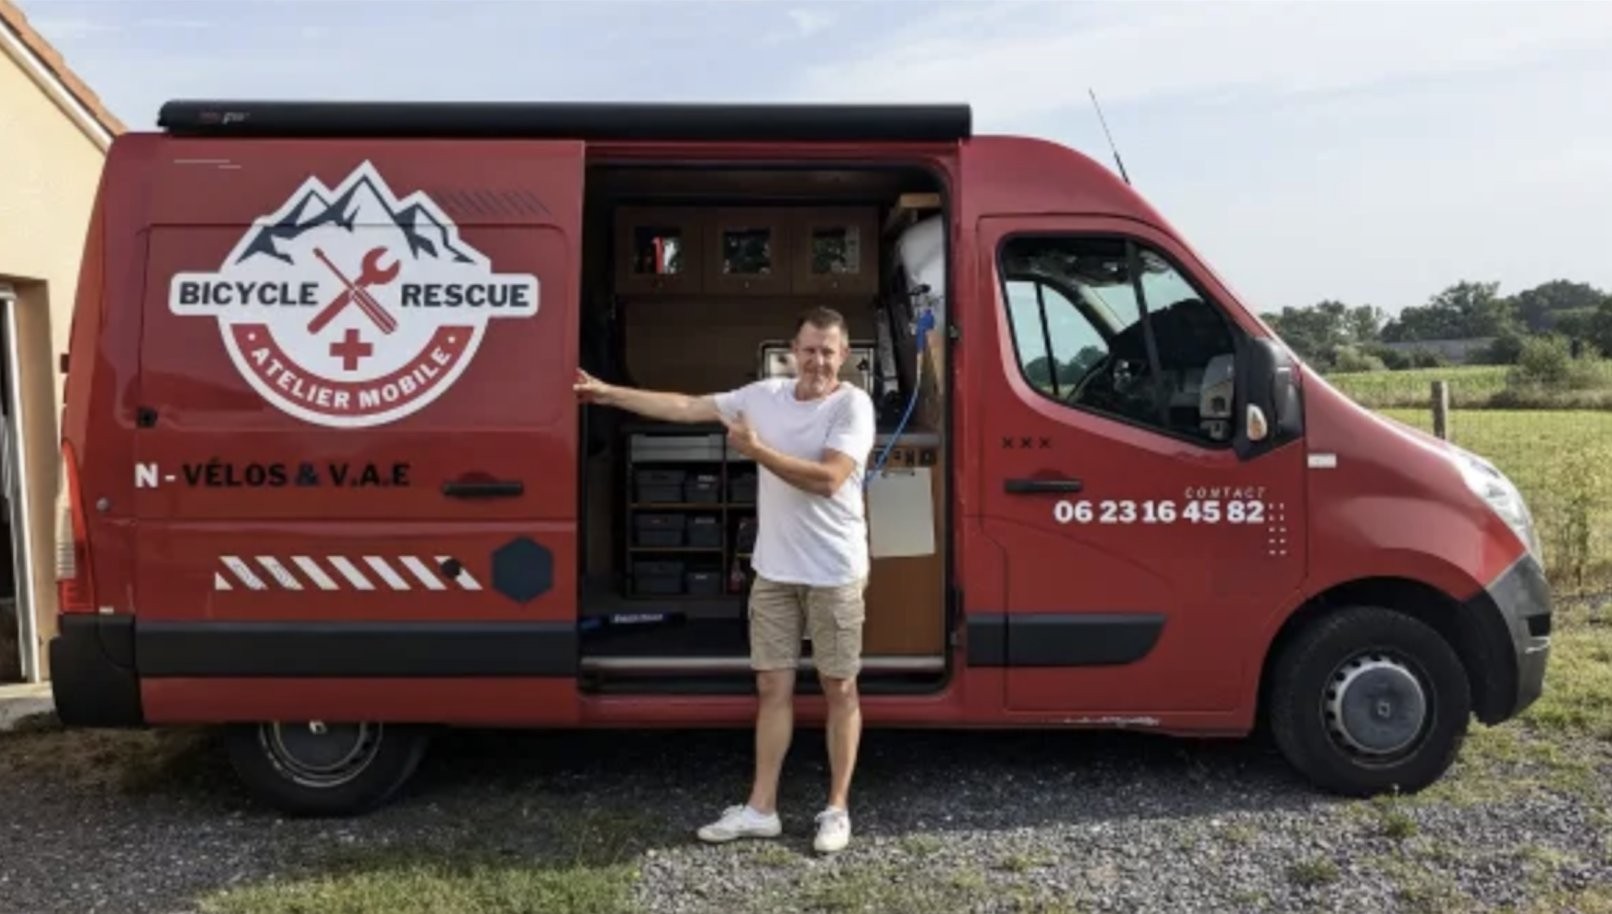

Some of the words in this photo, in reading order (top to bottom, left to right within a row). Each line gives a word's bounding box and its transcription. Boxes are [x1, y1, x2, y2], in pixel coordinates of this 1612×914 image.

[179, 281, 319, 306] BICYCLE
[401, 283, 530, 308] RESCUE
[251, 347, 350, 409] ATELIER
[359, 346, 451, 409] MOBILE
[182, 458, 288, 488] VÉLOS
[295, 463, 319, 488] &
[328, 463, 411, 488] V.A.E
[1184, 486, 1266, 499] CONTACT
[1054, 500, 1093, 524] 06
[1099, 500, 1137, 524] 23
[1142, 500, 1177, 524] 16
[1182, 500, 1221, 524] 45
[1226, 500, 1265, 524] 82
